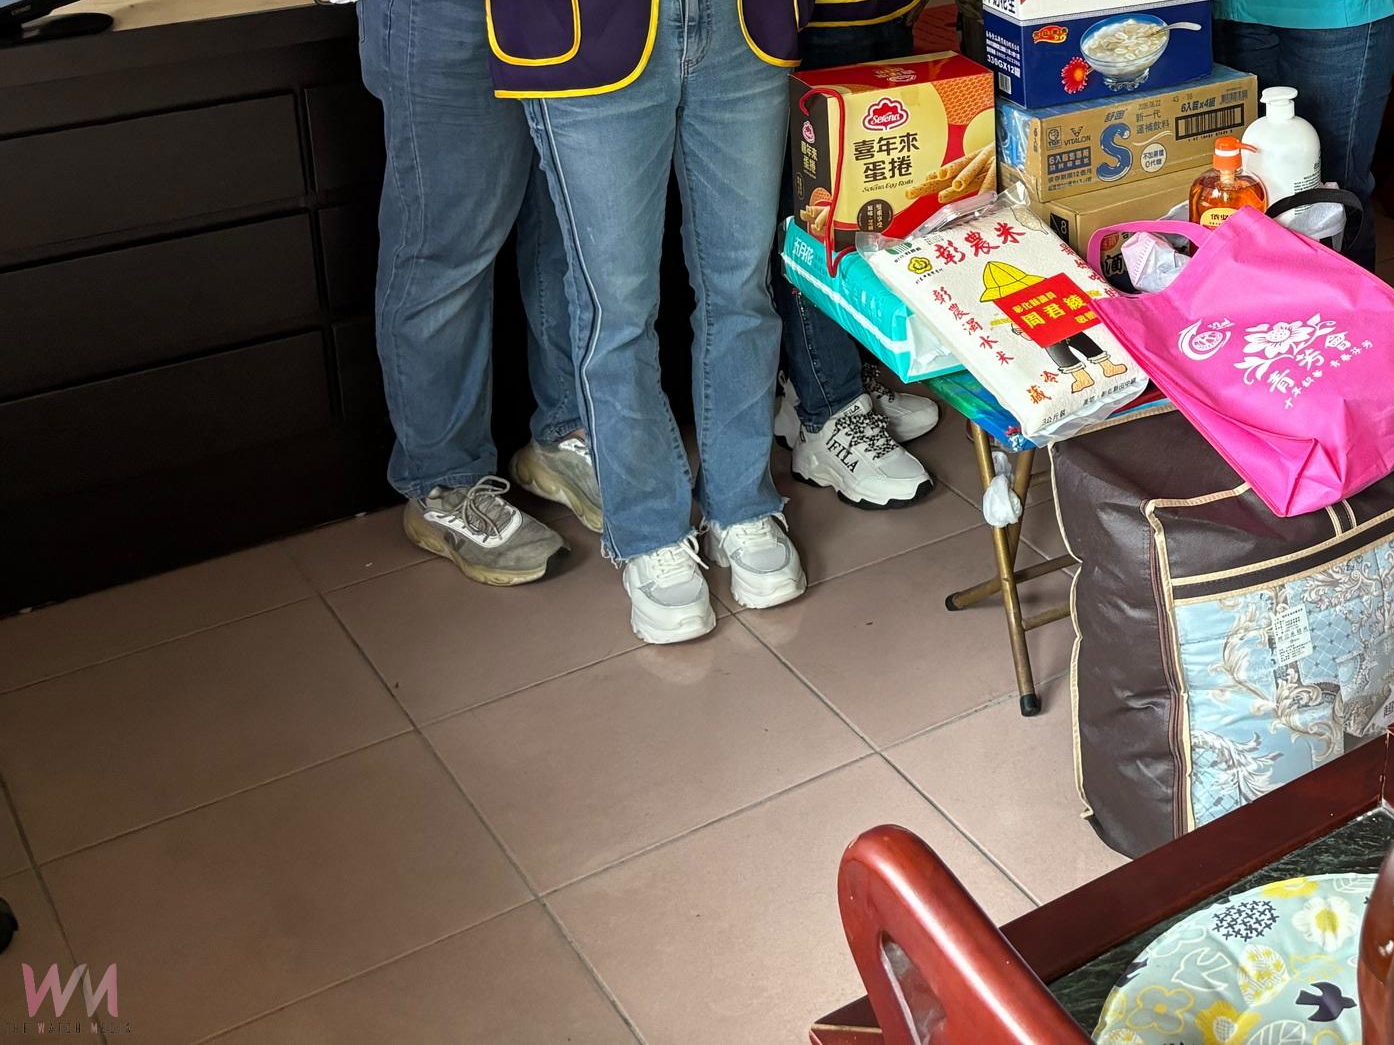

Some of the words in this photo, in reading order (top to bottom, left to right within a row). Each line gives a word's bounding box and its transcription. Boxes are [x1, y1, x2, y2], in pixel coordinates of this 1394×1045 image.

[853, 132, 920, 162] 喜年來
[1063, 135, 1091, 146] VITALON
[863, 154, 912, 184] 蛋捲
[934, 221, 1026, 265] 彰農米
[827, 439, 860, 474] FILA
